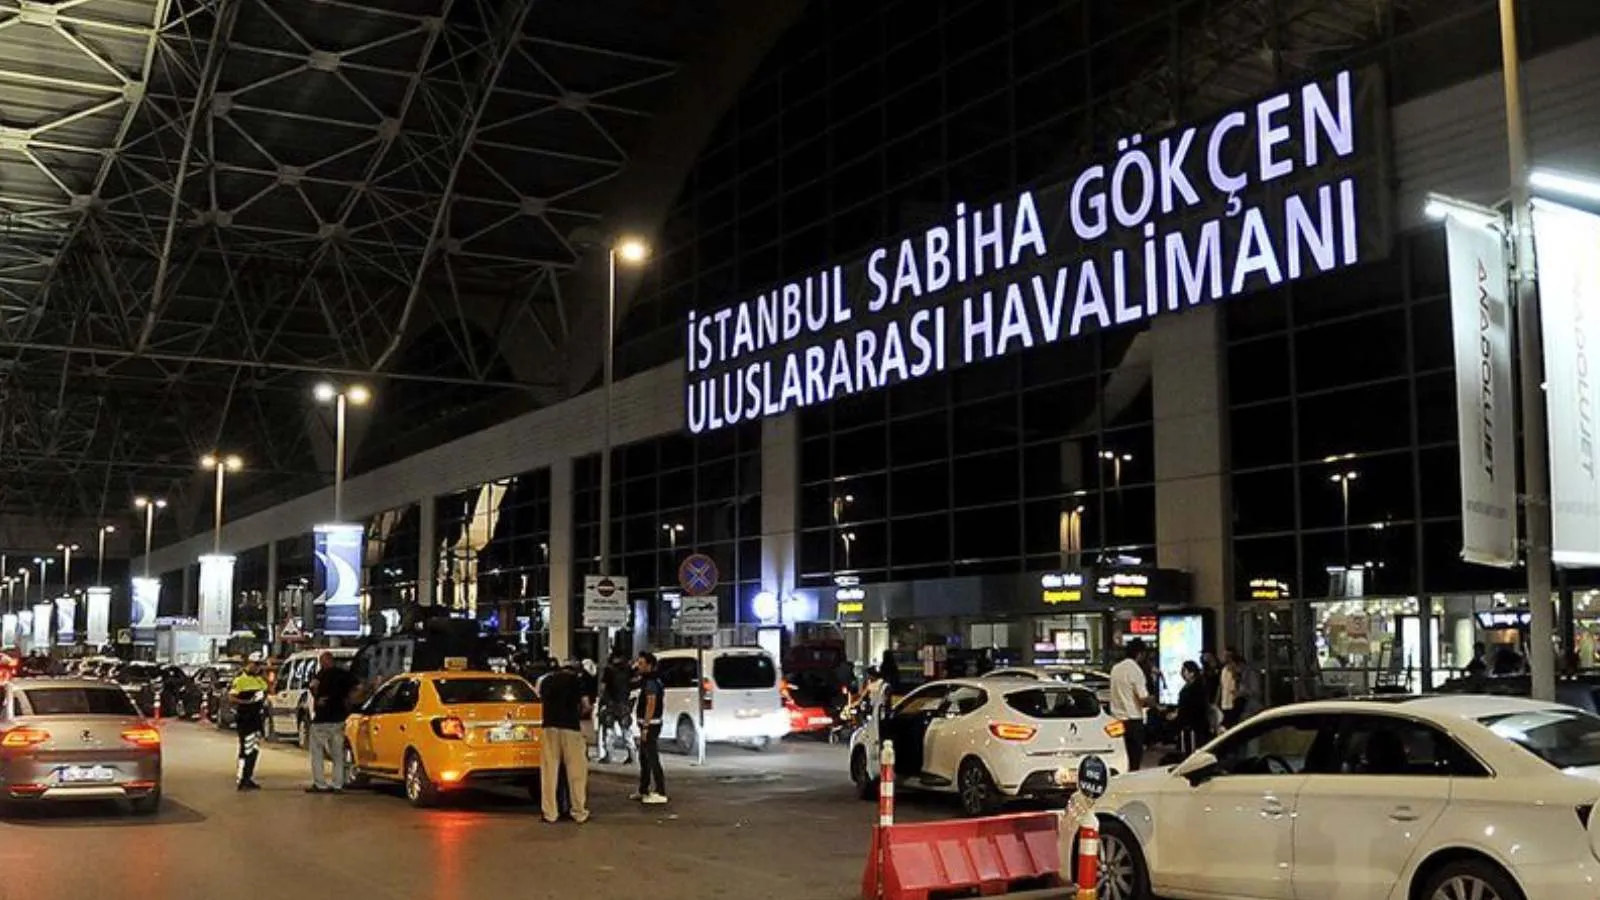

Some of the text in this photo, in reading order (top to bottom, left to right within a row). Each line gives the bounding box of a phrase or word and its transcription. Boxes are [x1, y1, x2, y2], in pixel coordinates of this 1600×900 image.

[687, 70, 1354, 373] İSTANBUL SABİHA GÖKÇEN
[687, 178, 1358, 434] ULUSLARARASI HAVALİMANI
[1477, 257, 1495, 483] ANADOLUJET
